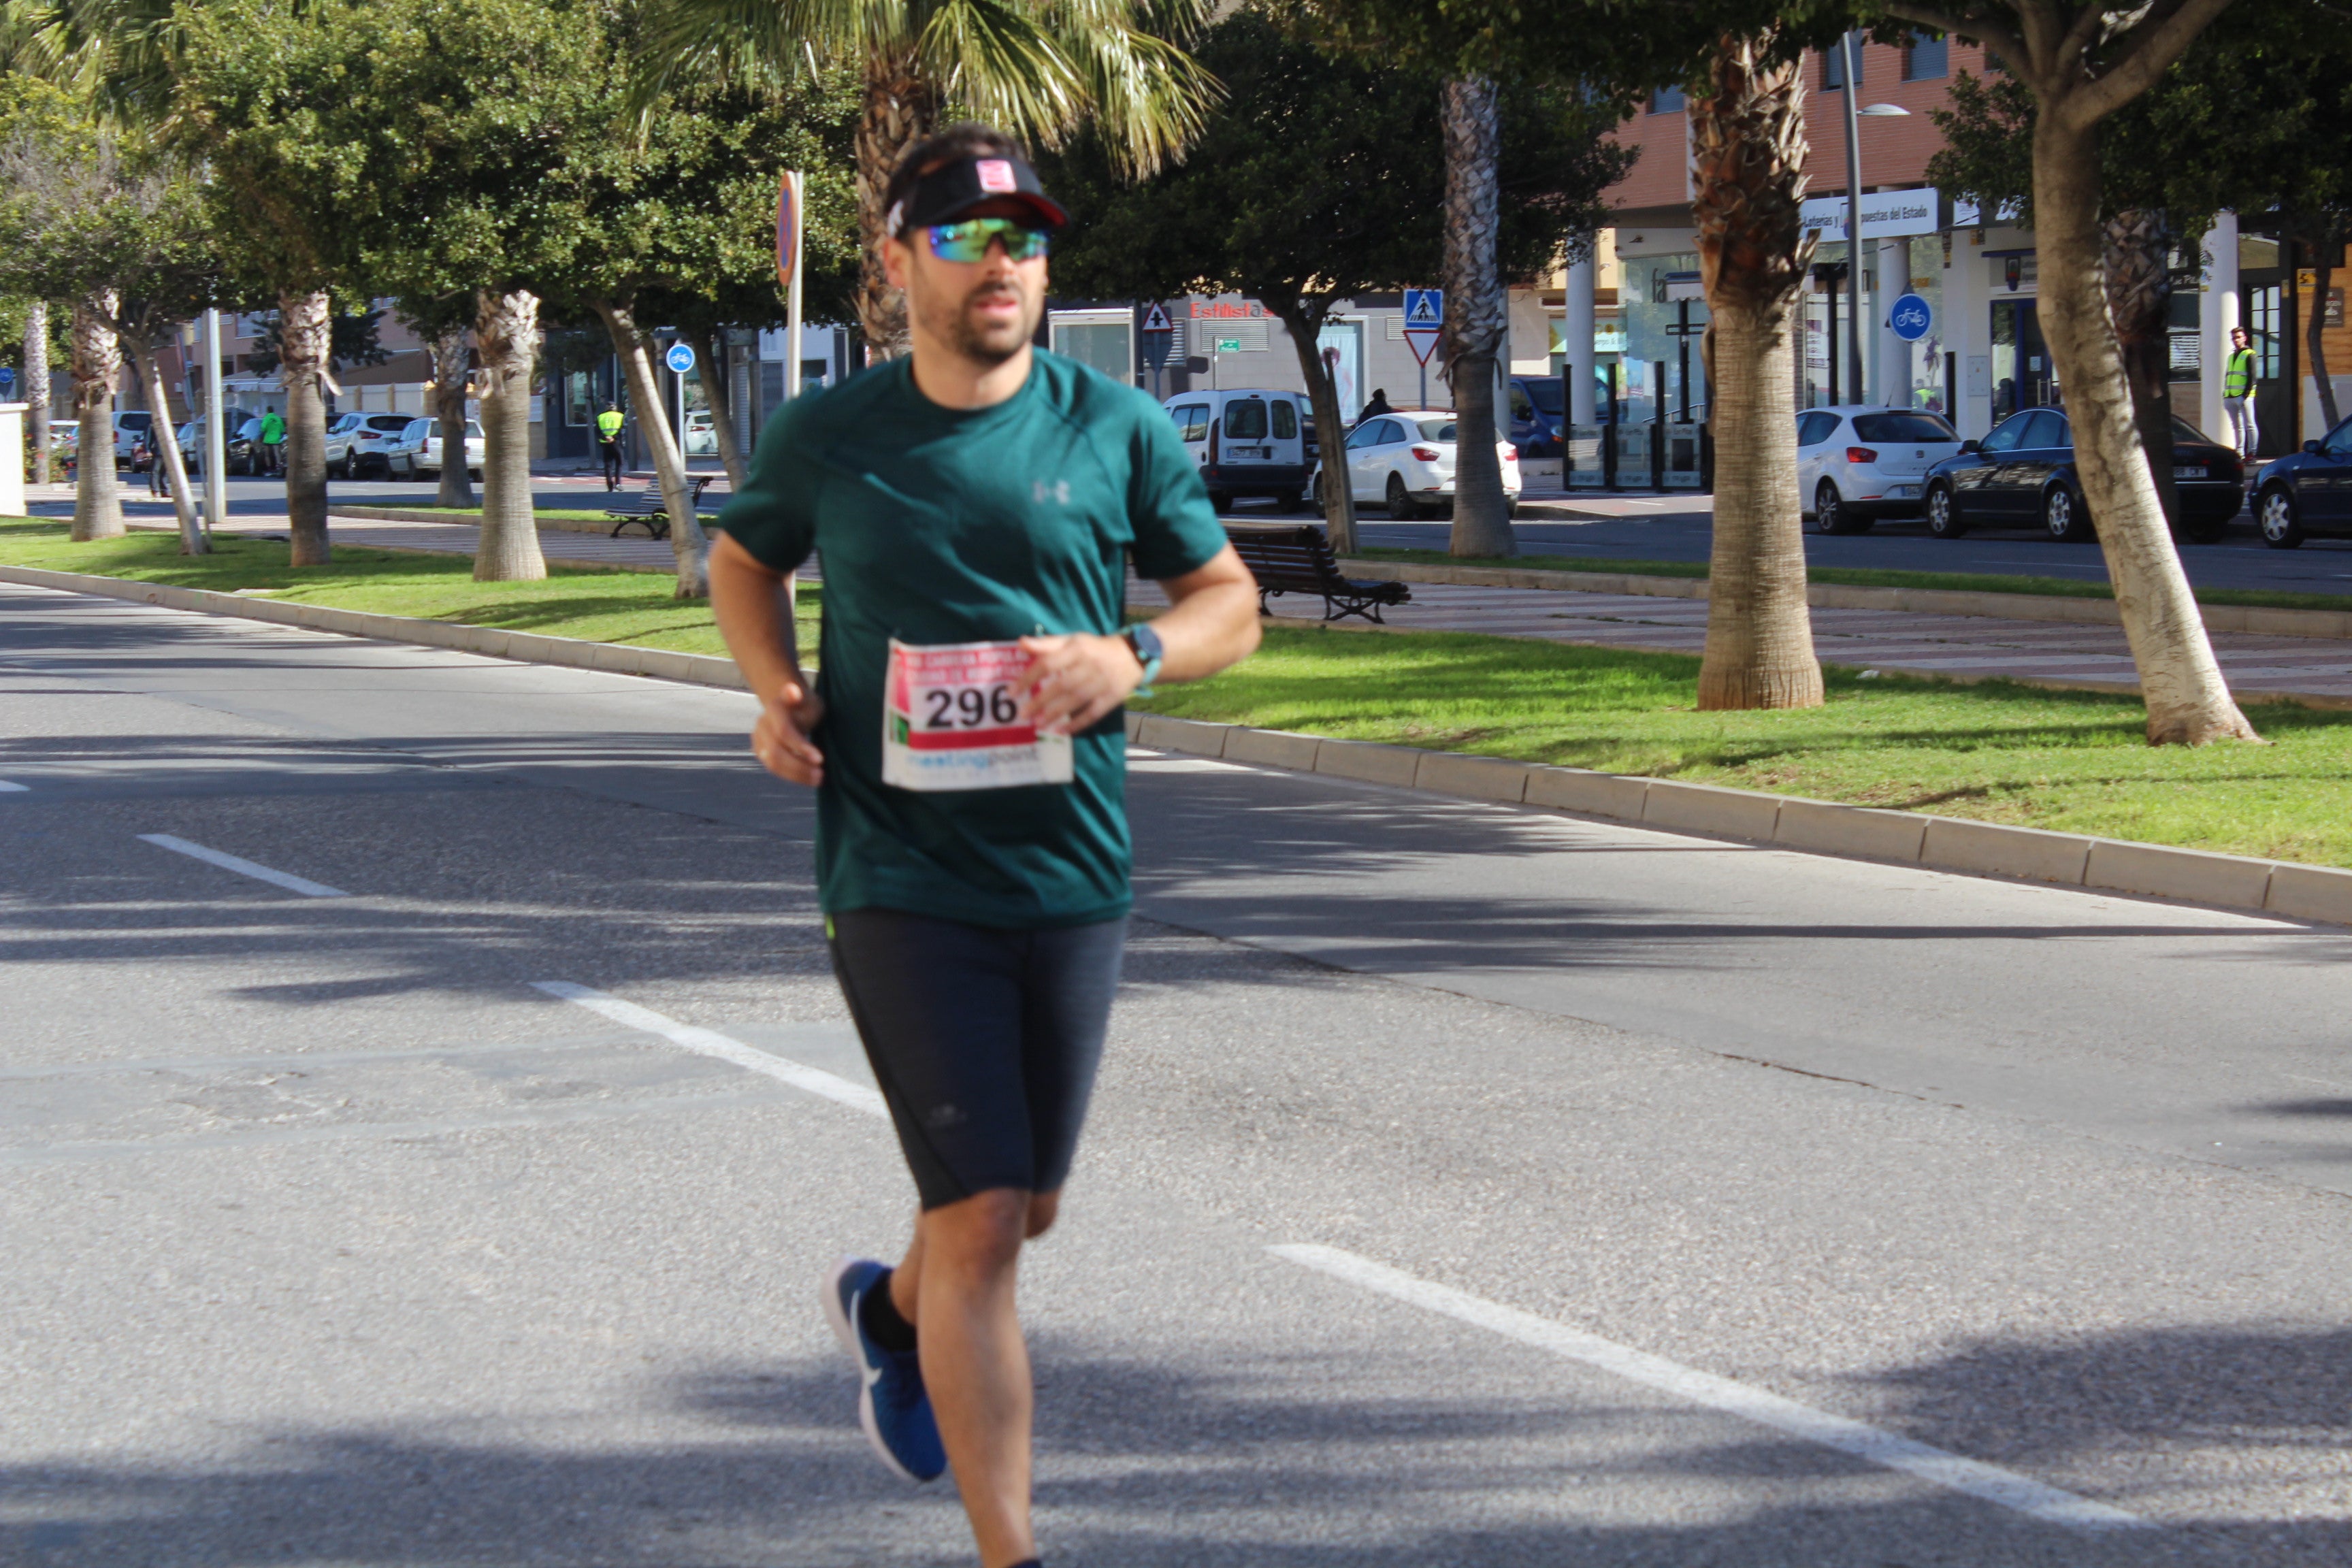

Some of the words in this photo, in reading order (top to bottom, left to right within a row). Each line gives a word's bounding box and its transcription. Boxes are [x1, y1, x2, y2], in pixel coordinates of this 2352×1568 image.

[1804, 213, 1833, 228] Loterías
[1861, 209, 1889, 227] puestas
[1890, 206, 1901, 220] del
[1903, 204, 1928, 219] Estado
[1190, 302, 1275, 318] Estilistas
[926, 685, 1017, 728] 296
